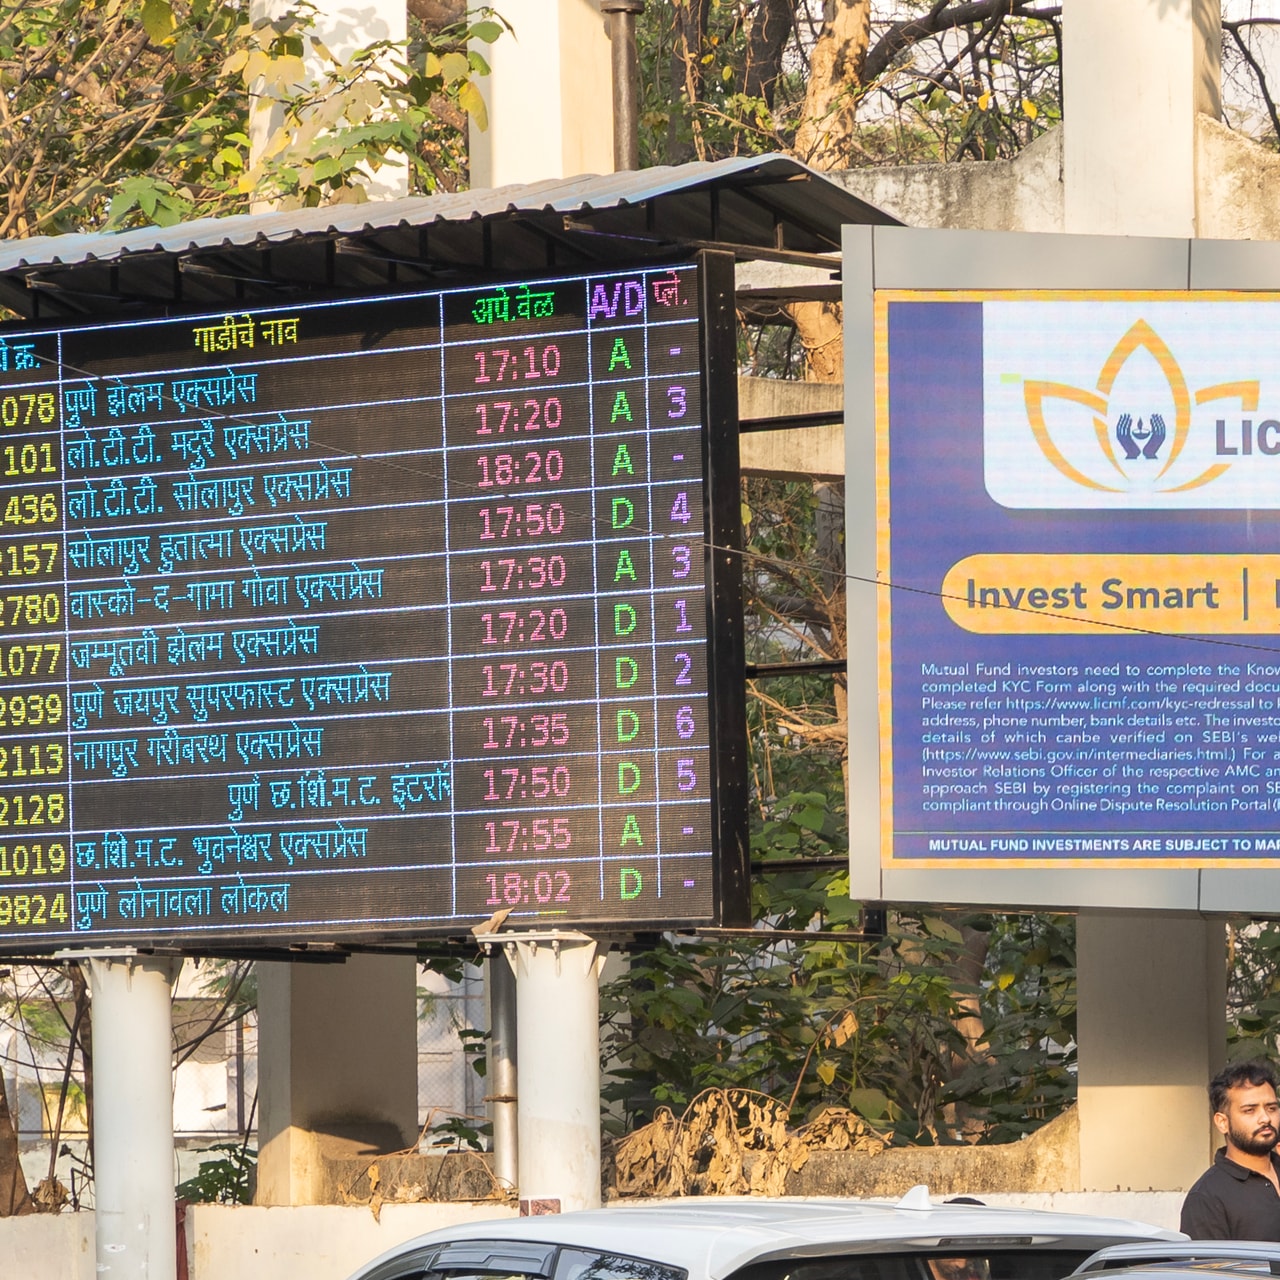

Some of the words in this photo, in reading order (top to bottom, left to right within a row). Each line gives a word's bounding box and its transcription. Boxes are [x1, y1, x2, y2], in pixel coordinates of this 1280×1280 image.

[194, 314, 254, 352] गाडीचे
[261, 319, 299, 344] नाव
[590, 281, 644, 319] A/D
[65, 380, 97, 428] पुणे
[107, 376, 164, 417] झेलम
[172, 368, 257, 412] एक्सप्रेस
[475, 345, 560, 383] 17:10
[608, 337, 632, 372] A
[224, 413, 310, 459] एक्सप्रेस
[476, 398, 562, 434] 17:20
[611, 390, 633, 422] A
[667, 386, 686, 418] 3
[173, 473, 254, 515] सोलापुर
[264, 462, 352, 505] एक्सप्रेस
[477, 451, 563, 487] 18:20
[612, 443, 634, 475] A
[69, 532, 150, 575] सोलापुर
[240, 514, 327, 560] एक्सप्रेस
[479, 503, 564, 539] 17:50
[612, 496, 635, 529] D
[670, 492, 691, 523] 4
[243, 571, 289, 605] गोवा
[295, 562, 383, 608] एक्सप्रेस
[480, 556, 566, 591] 17:30
[615, 549, 637, 581] A
[673, 546, 690, 578] 3
[966, 579, 1088, 610] Invest
[1101, 579, 1219, 610] Smart
[167, 629, 223, 664] झेलम
[232, 618, 319, 663] एक्सप्रेस
[481, 609, 567, 643] 17:20
[614, 603, 637, 634] D
[674, 600, 691, 632] 1
[73, 682, 104, 729] पुणे
[114, 686, 179, 724] जयपुर
[186, 679, 295, 721] सुपरफास्ट
[301, 665, 391, 710] एक्सप्रेस
[483, 661, 568, 696] 17:30
[616, 656, 639, 687] D
[675, 652, 691, 685] 2
[922, 697, 967, 710] Please
[970, 697, 1003, 709] refer
[1005, 697, 1255, 712] https://www.licmf.com/kyc-redressal
[1258, 699, 1274, 709] to
[75, 739, 138, 777] नागपुर
[148, 728, 228, 764] गरीबरथ
[236, 721, 323, 764] एक्सप्रेस
[483, 713, 569, 748] 17:35
[618, 710, 640, 740] D
[676, 706, 694, 738] 6
[921, 731, 972, 743] details
[980, 731, 996, 743] of
[1003, 731, 1047, 743] which
[1055, 731, 1101, 743] canbe
[1109, 731, 1166, 743] verified
[1173, 734, 1193, 742] on
[1243, 748, 1267, 760] For
[484, 766, 571, 800] 17:50
[619, 762, 641, 792] D
[678, 759, 696, 790] 5
[279, 821, 368, 865] एक्सप्रेस
[485, 817, 572, 852] 17:55
[620, 815, 643, 847] A
[928, 839, 988, 850] MUTUAL
[990, 839, 1029, 850] FUND
[1032, 839, 1130, 850] INVESTMENTS
[1132, 839, 1162, 850] ARE
[1165, 839, 1230, 850] SUBJECT
[1231, 839, 1252, 850] TO
[77, 884, 107, 929] पुणे
[119, 882, 211, 917] लोनावला
[221, 877, 289, 913] लोकल
[486, 870, 571, 904] 18:02
[621, 868, 643, 898] D
